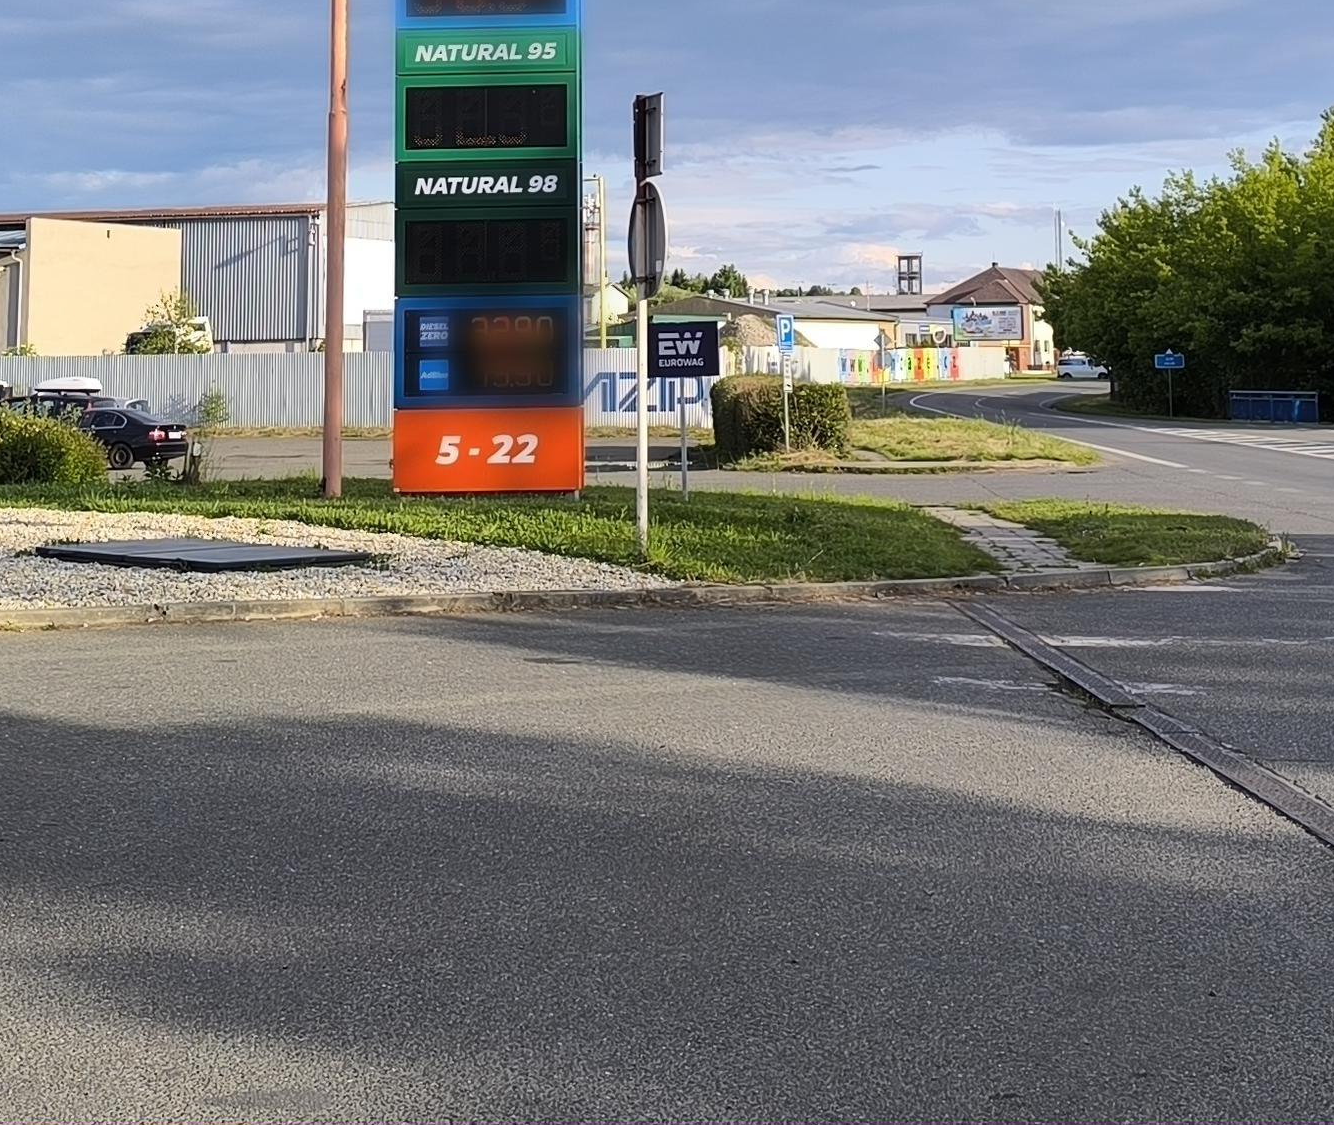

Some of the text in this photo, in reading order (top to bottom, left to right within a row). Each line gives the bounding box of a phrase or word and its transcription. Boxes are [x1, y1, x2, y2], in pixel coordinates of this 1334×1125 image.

[415, 42, 557, 62] NATURAL 95
[415, 175, 558, 195] NATURAL 98
[420, 322, 449, 331] DIESEL
[420, 331, 449, 340] ZERO
[780, 319, 791, 341] P
[658, 331, 703, 355] EW
[658, 357, 704, 368] EUROWAG
[435, 435, 461, 465] 5
[486, 434, 539, 464] 22
